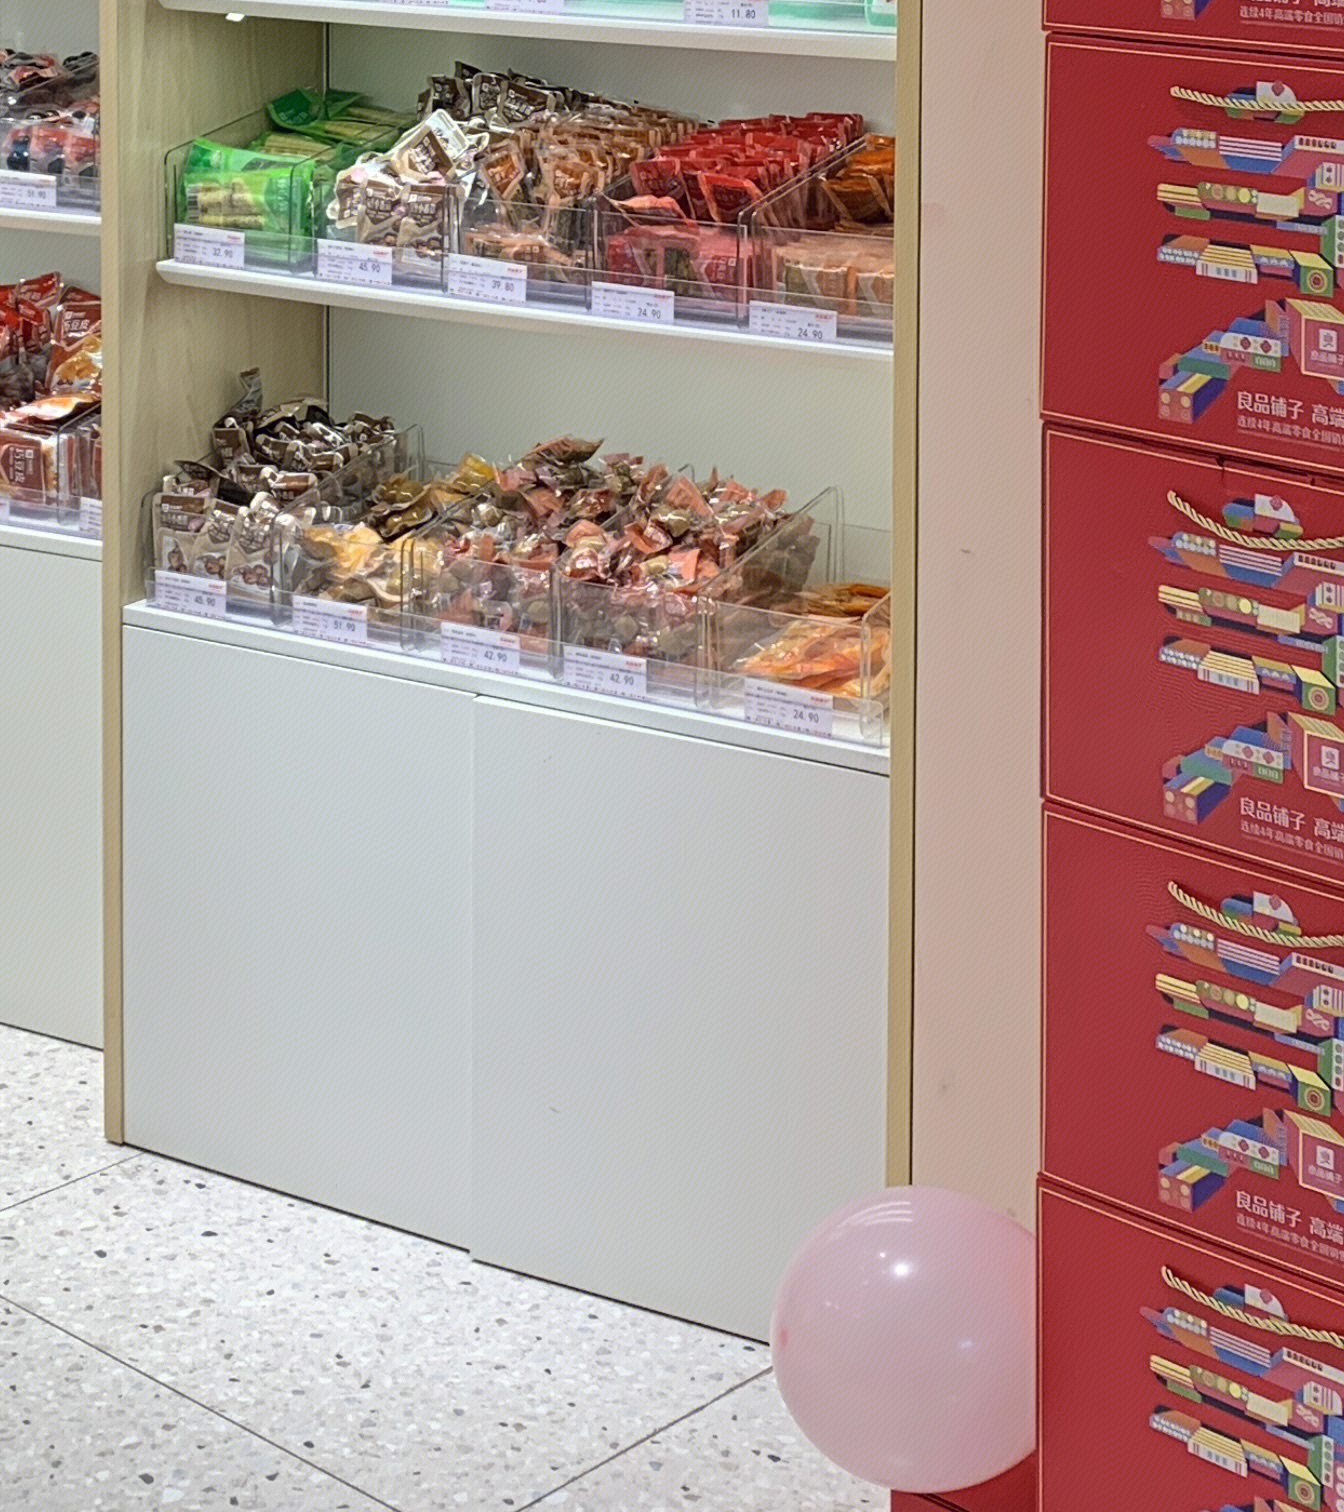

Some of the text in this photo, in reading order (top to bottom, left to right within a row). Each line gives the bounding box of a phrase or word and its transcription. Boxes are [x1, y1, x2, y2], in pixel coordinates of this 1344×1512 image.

[731, 9, 756, 20] 11.80
[797, 328, 823, 340] 24.90
[1237, 390, 1304, 420] 良品铺子
[610, 674, 634, 685] 42.90
[793, 710, 820, 723] 24.90
[1240, 796, 1306, 831] 良品铺子
[1236, 1189, 1302, 1228] 良品铺子
